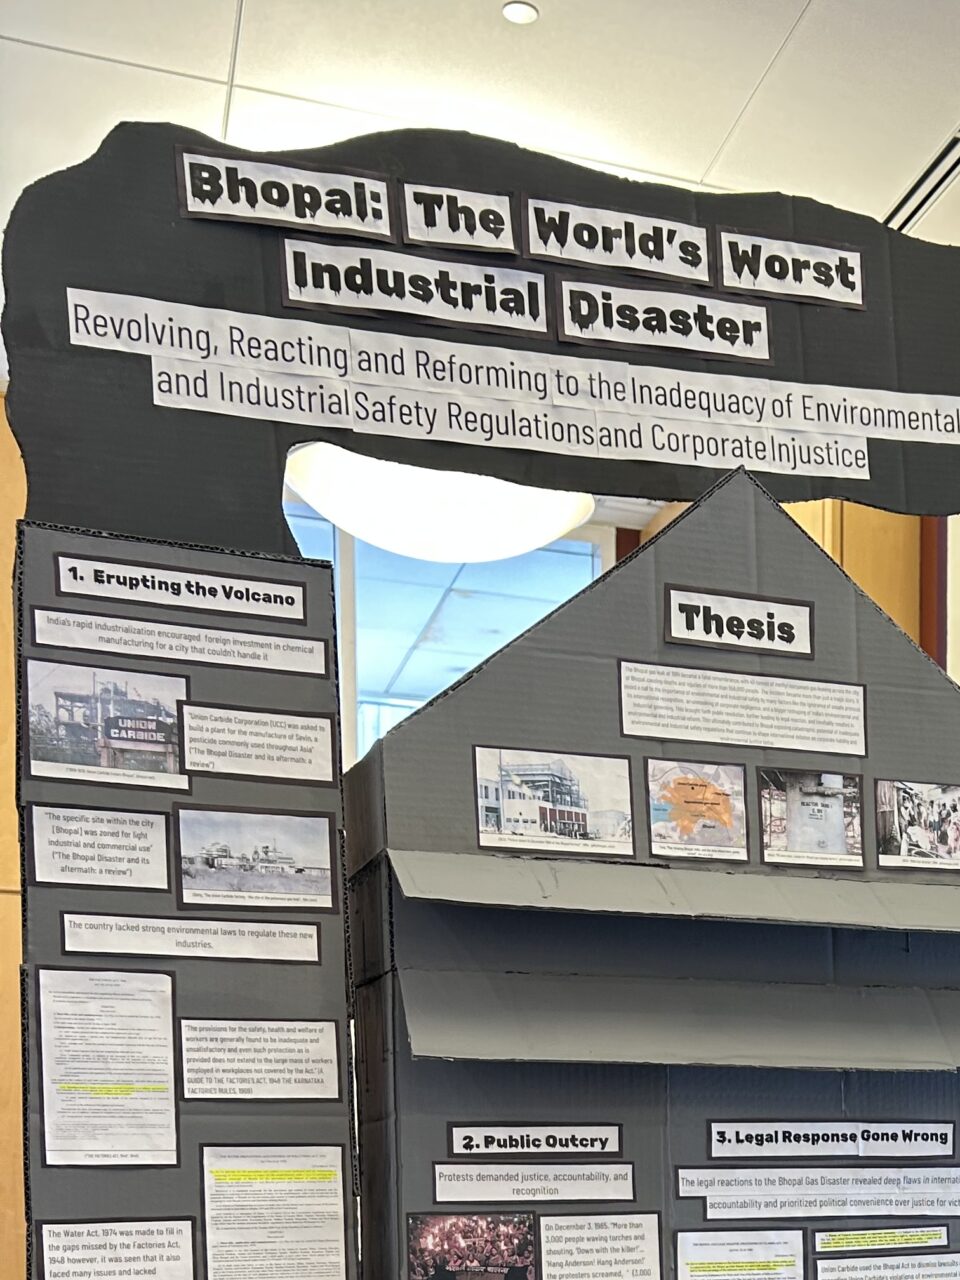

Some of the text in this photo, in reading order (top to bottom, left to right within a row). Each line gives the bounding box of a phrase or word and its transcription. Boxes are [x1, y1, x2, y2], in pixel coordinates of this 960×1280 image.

[189, 162, 856, 292] Bhopal: The World's Worst
[293, 251, 761, 346] Industrial Disaster
[74, 304, 960, 433] Revolving, Reacting and Reforming to the Inadequacy of Environmental
[158, 370, 866, 469] and Industrial Safety Regulations and Corporate Injustice
[68, 566, 295, 606] 1. Erupting the Volcano
[679, 602, 796, 644] Thesis
[119, 719, 156, 729] UNION
[111, 729, 165, 741] CARBIDE
[69, 921, 82, 929] The
[84, 921, 113, 932] country
[115, 923, 139, 932] lacked
[142, 925, 165, 935] strong
[167, 926, 218, 936] environmental
[221, 927, 236, 936] laws
[239, 928, 246, 936] to
[248, 929, 276, 938] regulate
[279, 930, 297, 938] these
[176, 939, 212, 949] industries.
[463, 1134, 608, 1151] 2. Public Outcry
[717, 1130, 947, 1146] 3. Legal Response Gone Wrong
[439, 1172, 628, 1183] Protests demanded justice, accountability, and
[681, 1178, 695, 1187] The
[697, 1178, 715, 1189] legal
[718, 1177, 752, 1187] reactions
[755, 1178, 762, 1186] to
[764, 1177, 776, 1185] the
[779, 1177, 803, 1188] Bhopal
[805, 1176, 818, 1185] Gas
[821, 1176, 849, 1185] Disaster
[852, 1176, 882, 1185] revealed
[884, 1176, 900, 1187] deep
[903, 1176, 921, 1184] flaws
[923, 1176, 929, 1184] in
[513, 1187, 558, 1196] recognition
